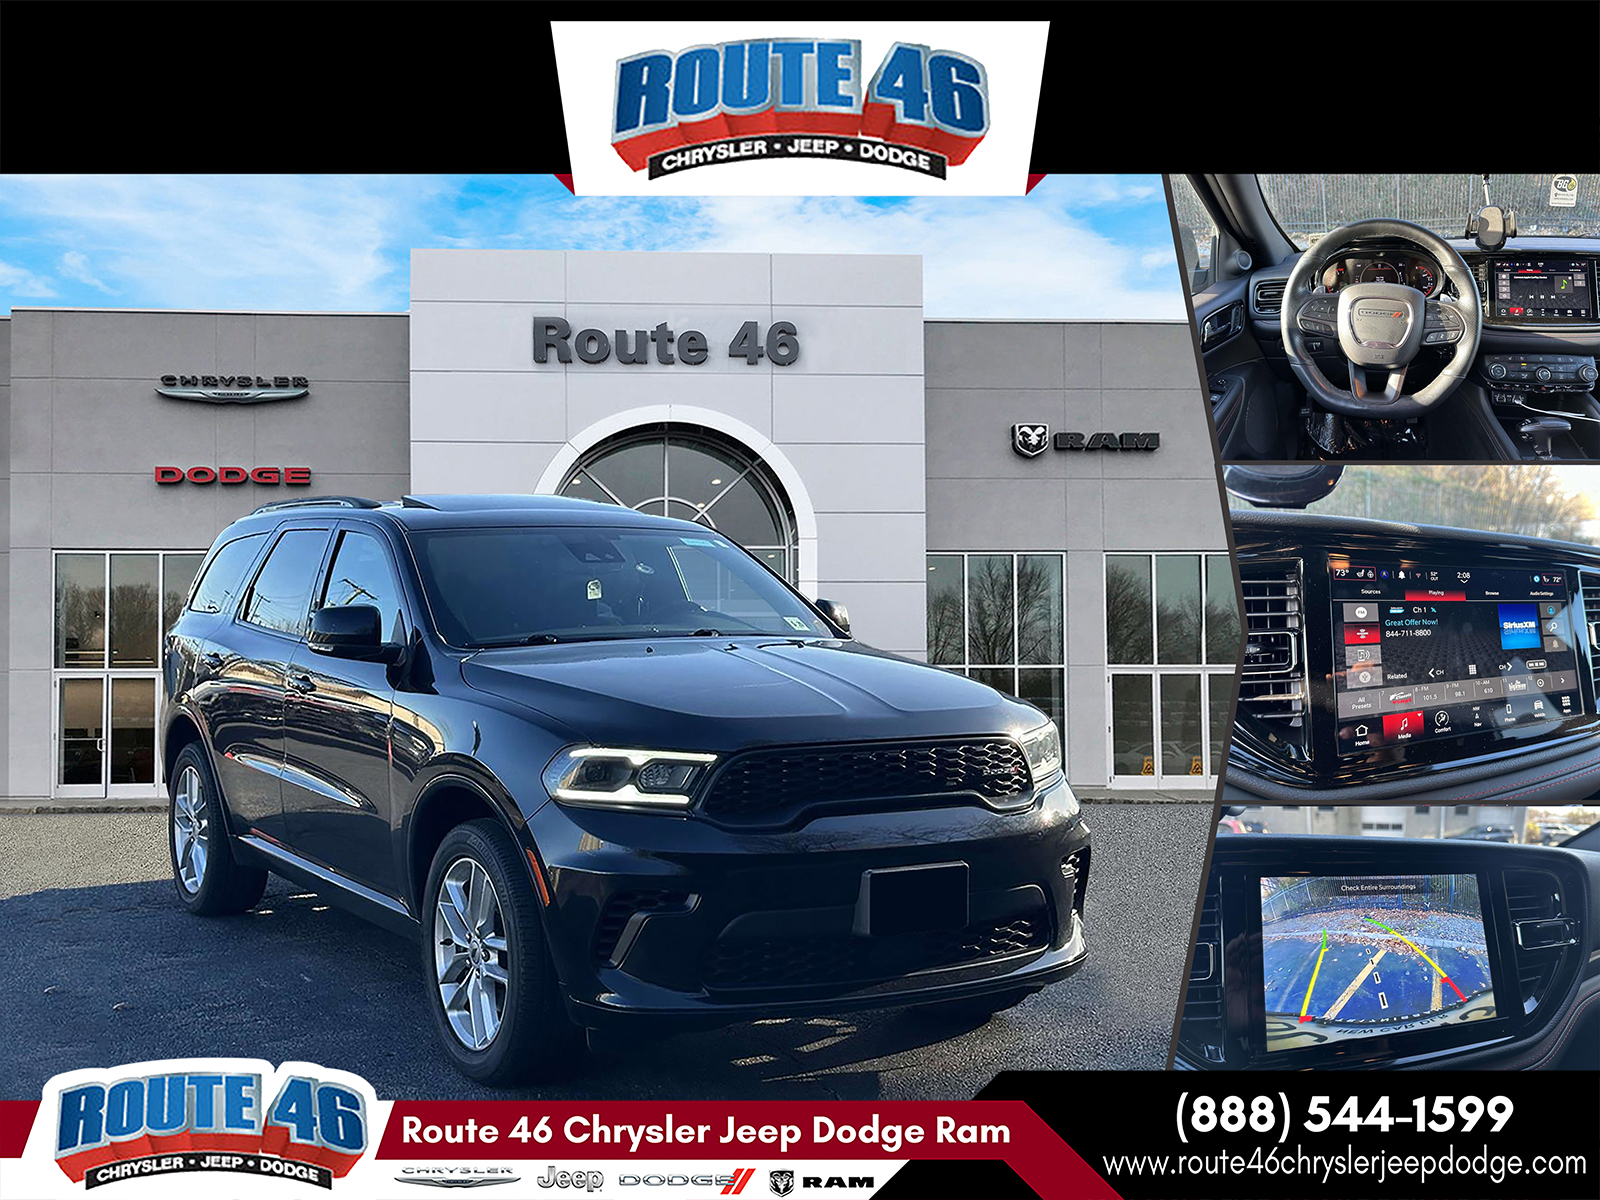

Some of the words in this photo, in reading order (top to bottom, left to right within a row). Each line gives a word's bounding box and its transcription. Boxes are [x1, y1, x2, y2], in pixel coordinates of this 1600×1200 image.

[533, 316, 708, 365] Route
[728, 320, 800, 366] 46
[160, 375, 309, 387] CHRYSLER
[1054, 432, 1160, 450] RAM
[154, 466, 311, 486] DODGE
[1503, 621, 1536, 629] SiriusXM
